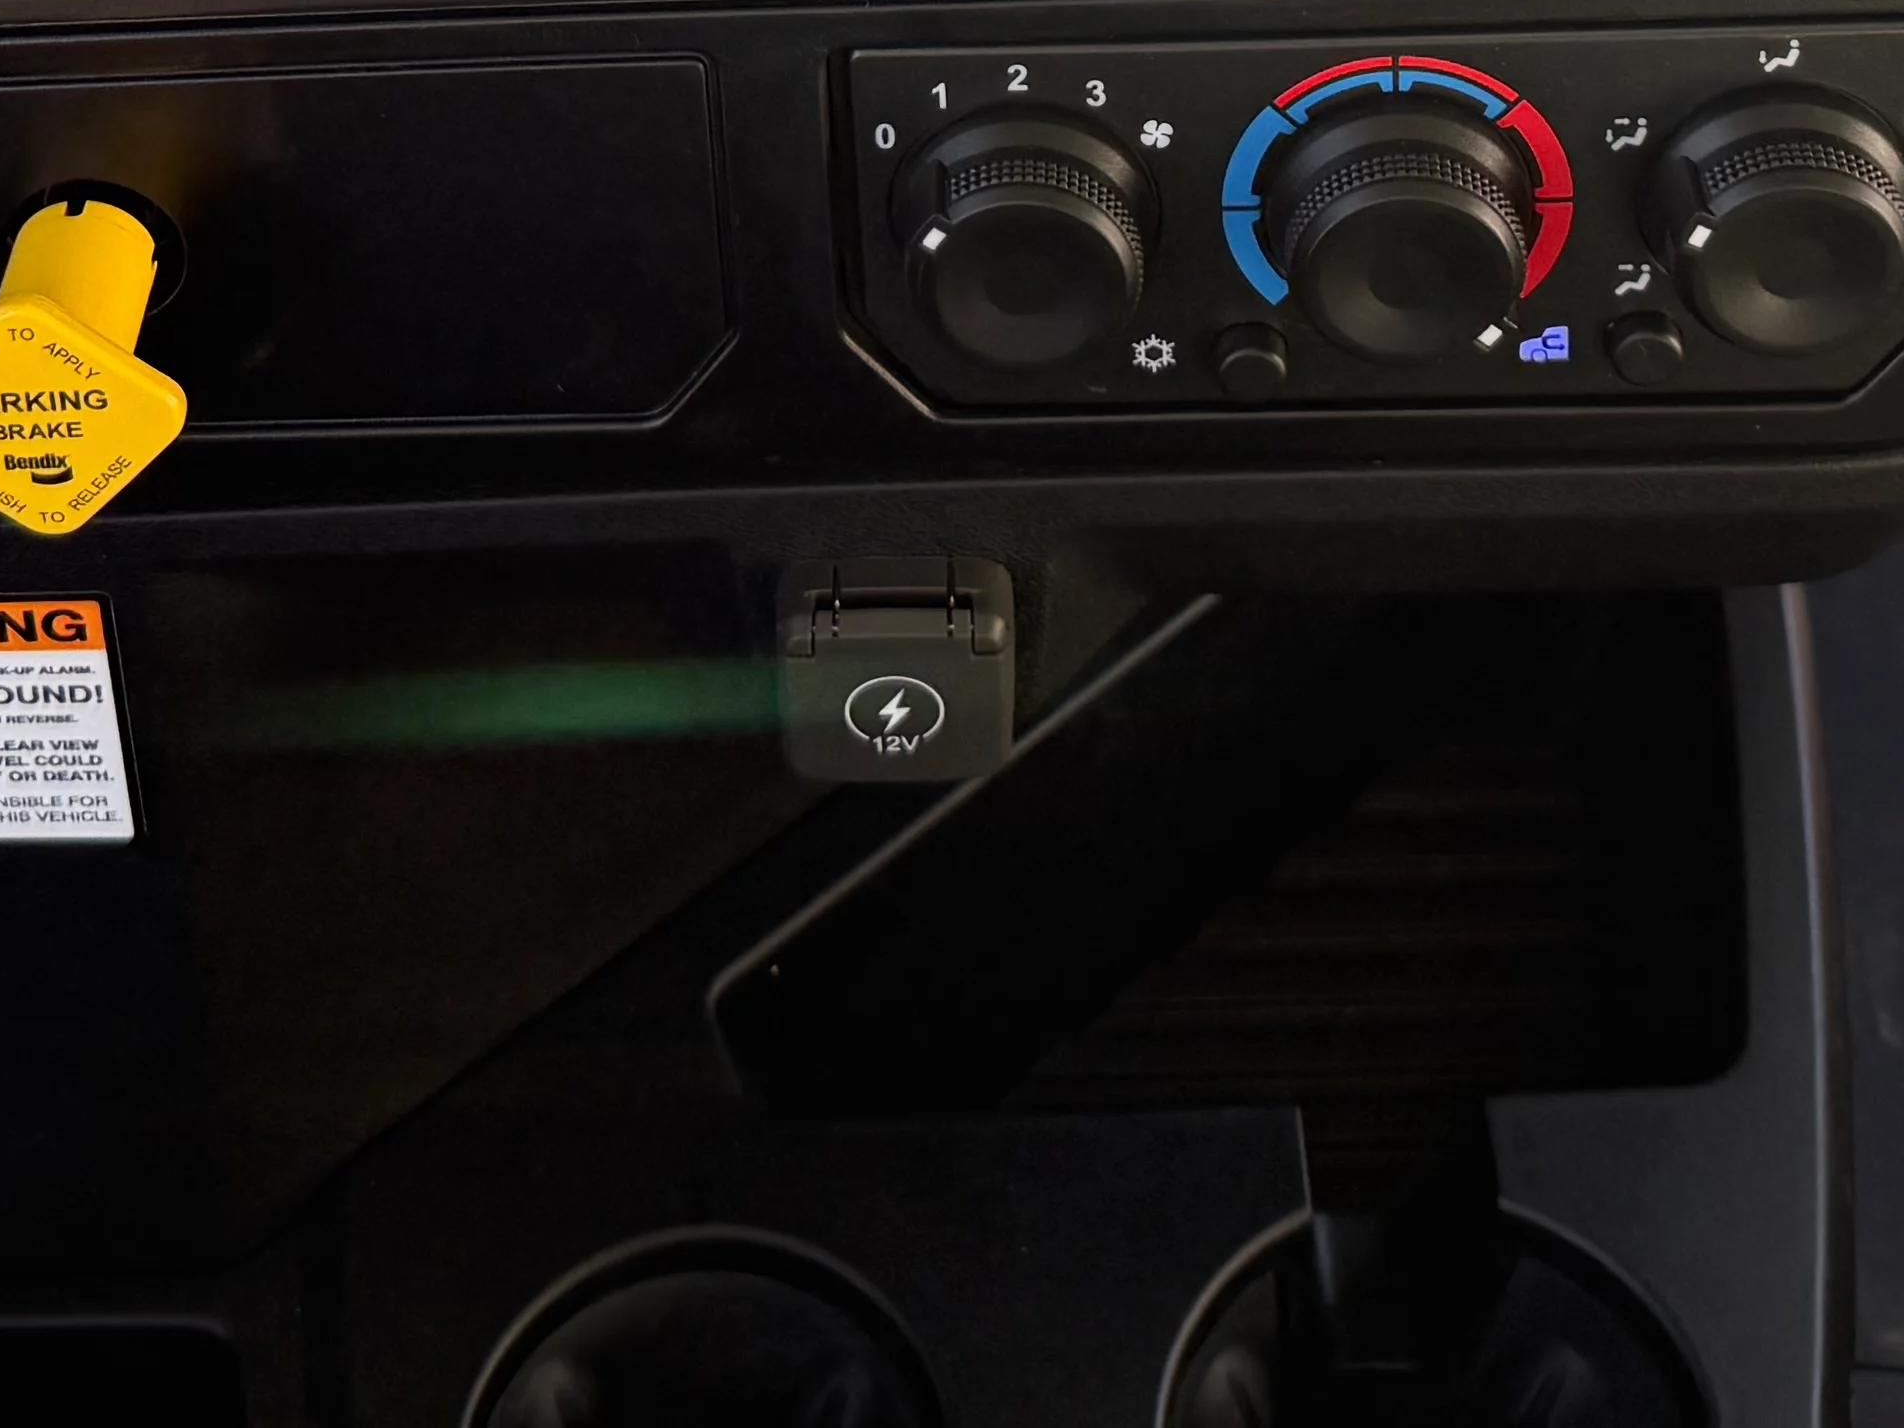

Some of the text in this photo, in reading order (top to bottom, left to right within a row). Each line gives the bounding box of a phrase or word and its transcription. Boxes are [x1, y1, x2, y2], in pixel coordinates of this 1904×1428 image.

[1006, 64, 1030, 92] 2
[931, 83, 948, 110] 1
[1085, 80, 1107, 107] 3
[874, 123, 896, 149] 0
[7, 327, 35, 342] TO
[41, 341, 101, 381] APPLY
[4, 452, 70, 471] Bendix
[39, 510, 66, 524] TO
[67, 455, 133, 512] RELEASE
[49, 739, 100, 751] VIEW
[872, 734, 920, 754] 12V
[34, 754, 104, 766] COULD
[8, 770, 37, 782] OR
[43, 770, 115, 782] DEATH.
[68, 795, 109, 807] FOR
